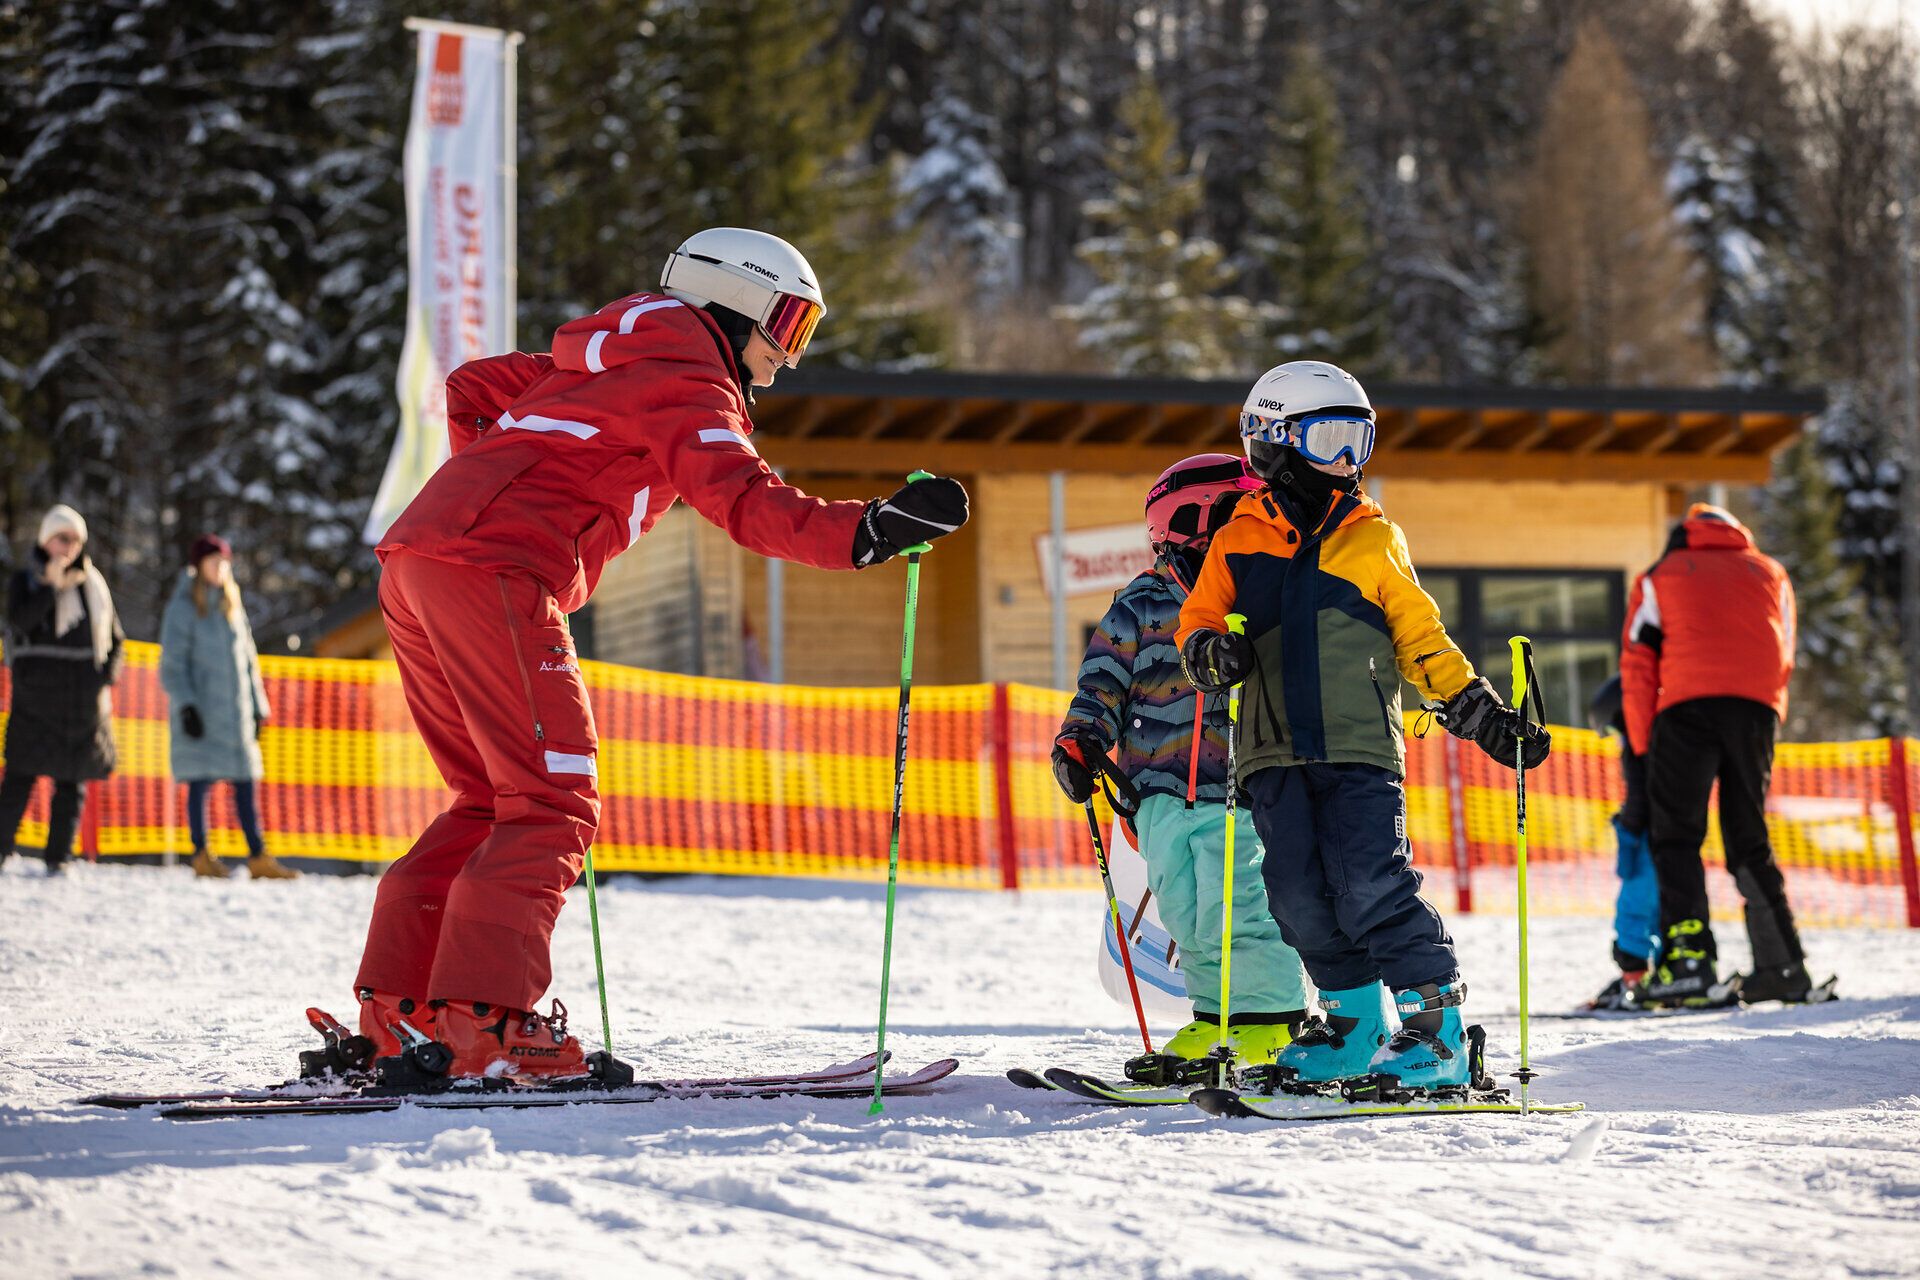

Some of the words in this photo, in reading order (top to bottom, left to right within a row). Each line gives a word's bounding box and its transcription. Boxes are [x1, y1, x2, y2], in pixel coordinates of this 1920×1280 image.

[741, 261, 780, 282] ATOMIC
[1258, 398, 1285, 412] uvex
[1147, 481, 1168, 501] vex
[509, 1046, 560, 1057] ATOMIC
[1403, 1060, 1439, 1070] HEAD
